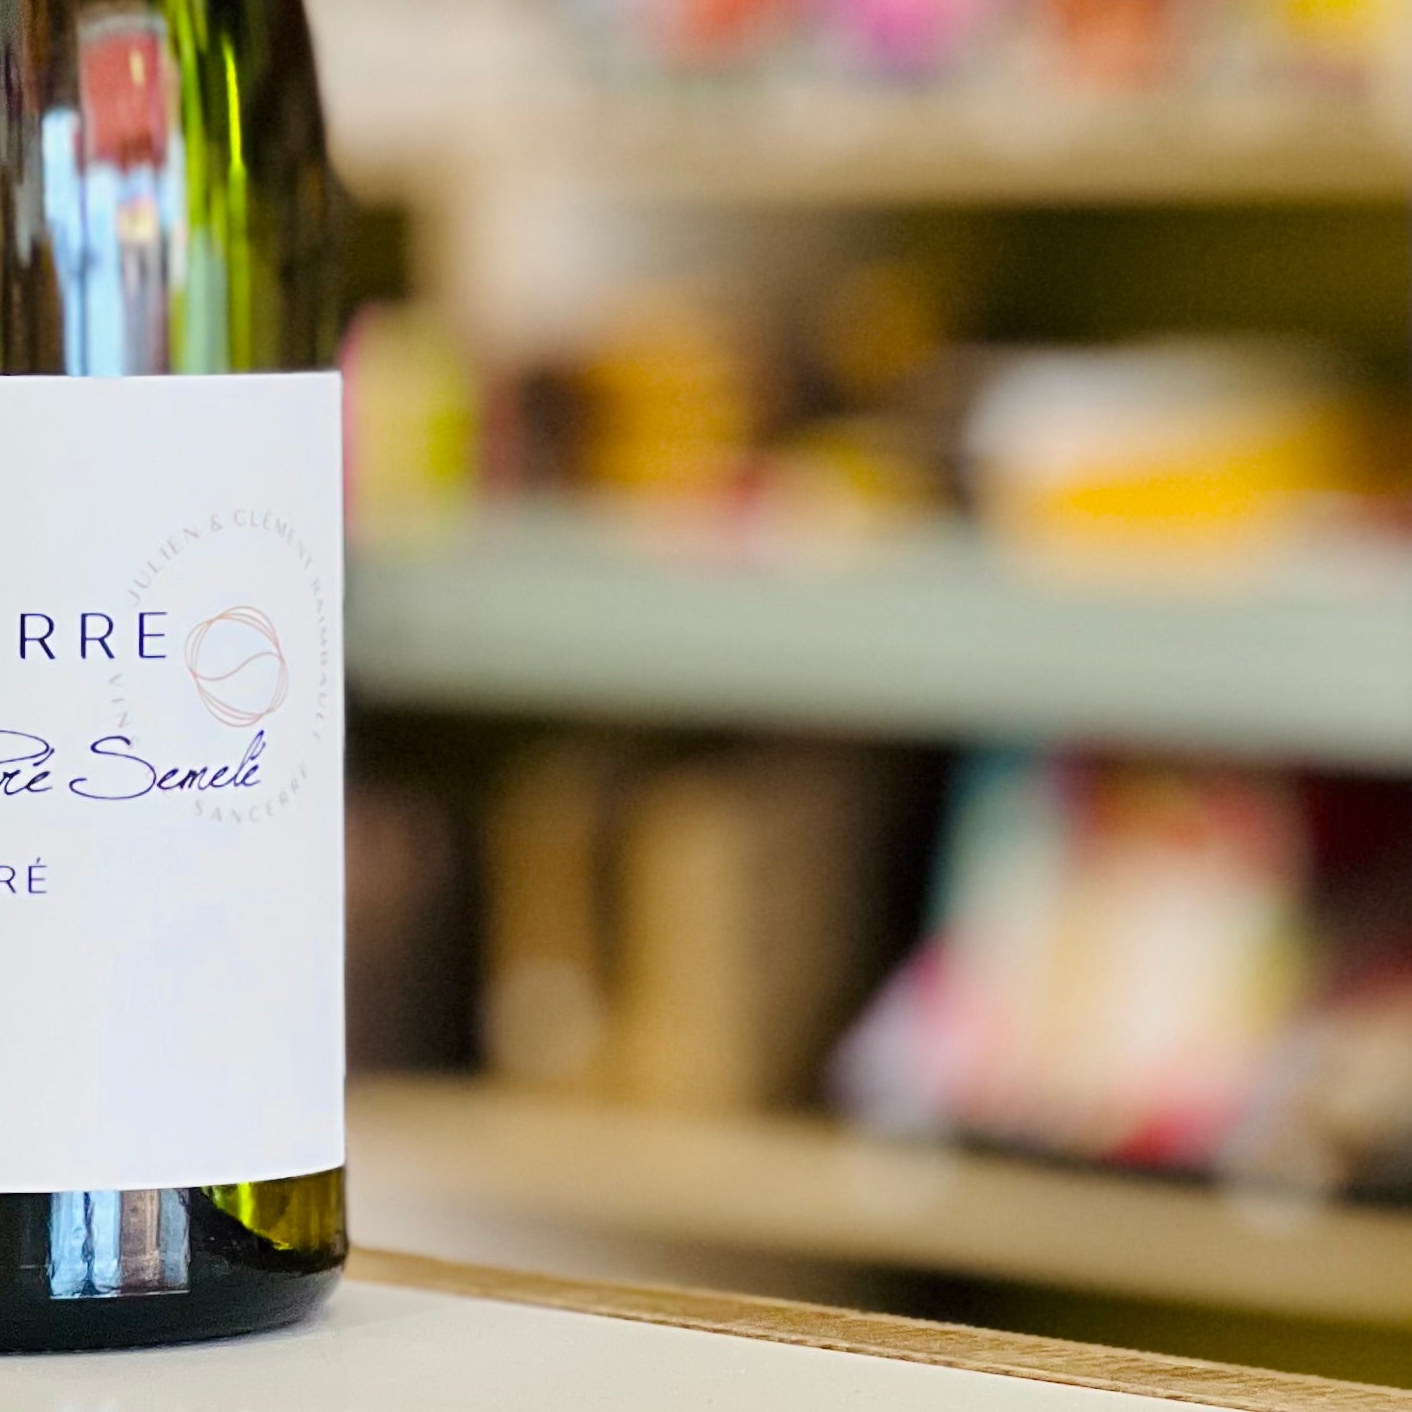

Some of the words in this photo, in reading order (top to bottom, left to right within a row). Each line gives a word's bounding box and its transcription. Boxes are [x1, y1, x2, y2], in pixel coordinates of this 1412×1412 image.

[127, 525, 200, 606] JULIEN
[209, 513, 223, 532] &
[195, 762, 308, 824] SANCERRE
